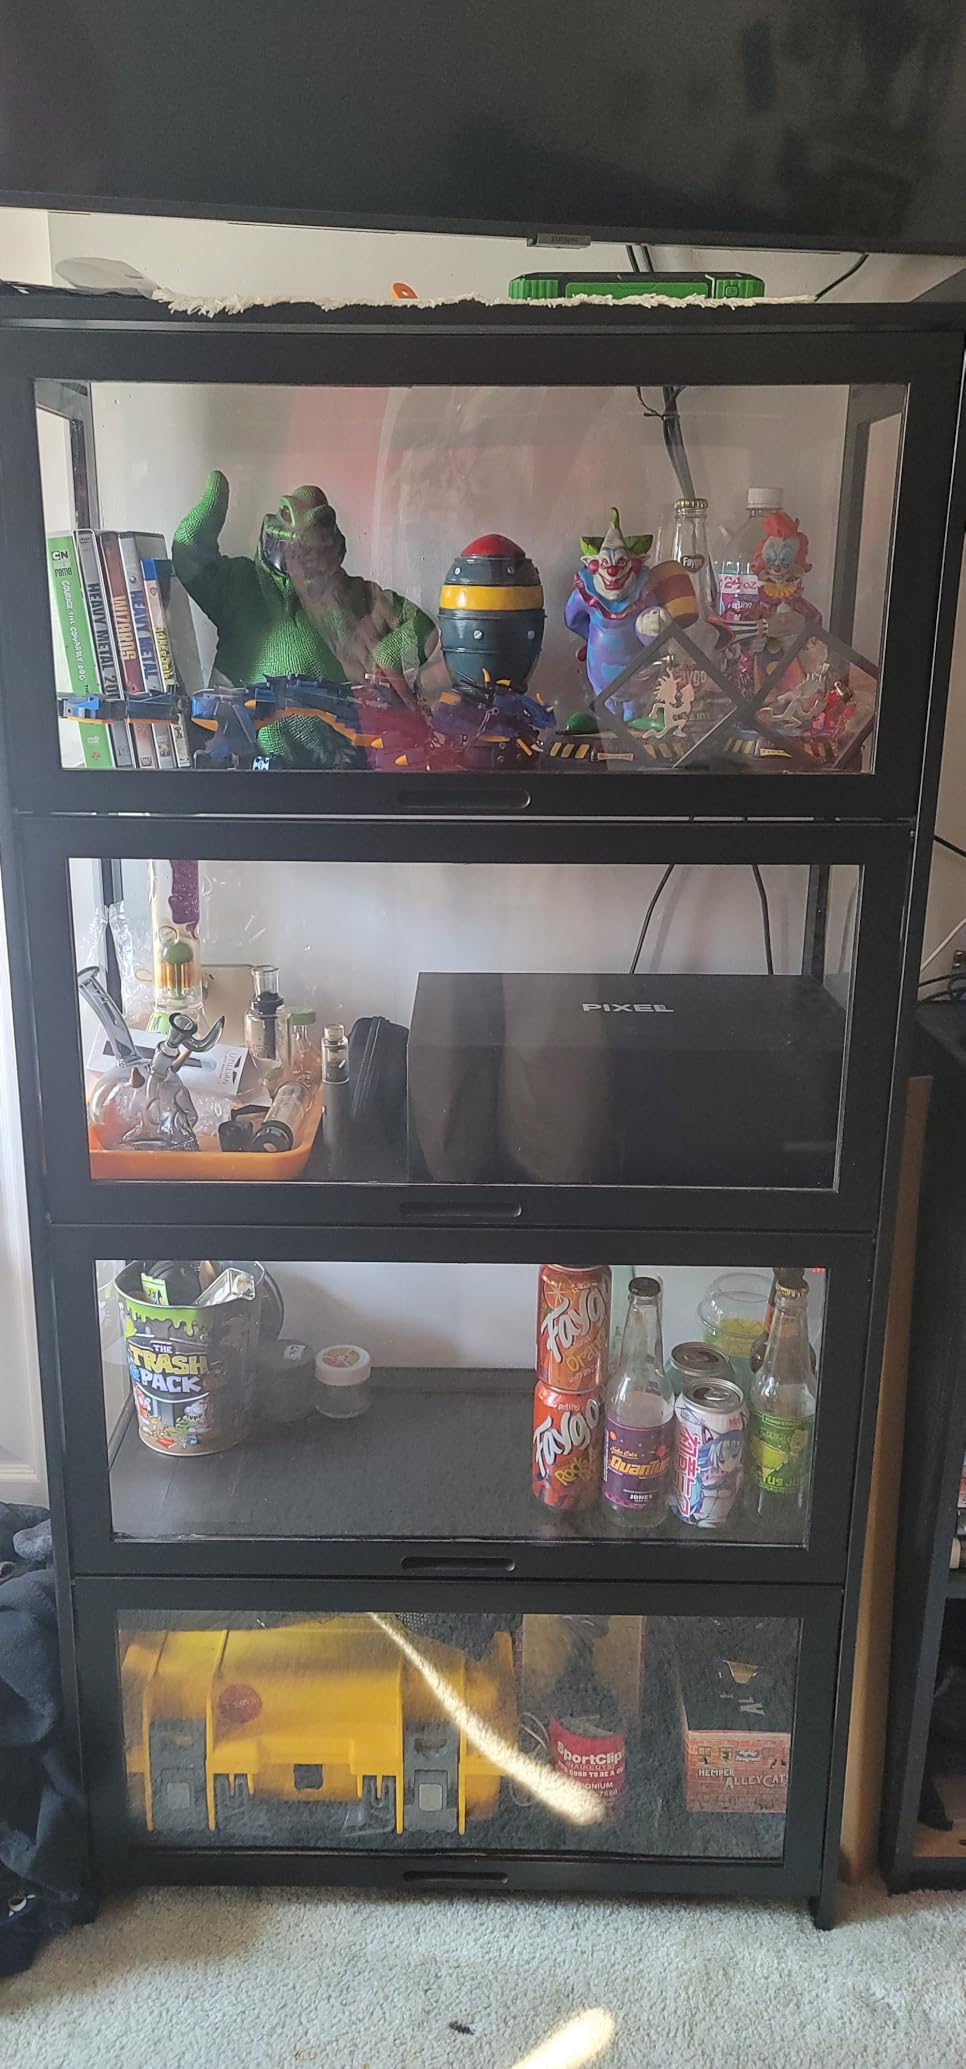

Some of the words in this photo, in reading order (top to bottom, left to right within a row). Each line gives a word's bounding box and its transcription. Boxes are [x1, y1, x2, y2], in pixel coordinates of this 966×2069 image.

[87, 583, 108, 624] HEAVY
[130, 591, 151, 633] HEAVY
[113, 595, 138, 661] WIZARDS
[96, 629, 116, 672] METAL
[138, 637, 160, 681] METAL
[582, 1003, 675, 1013] PIXEL
[128, 1343, 208, 1375] TRASH
[152, 1344, 174, 1354] THE
[140, 1368, 202, 1393] PACK
[533, 1399, 600, 1478] Faygo
[557, 1741, 624, 1766] SportClip
